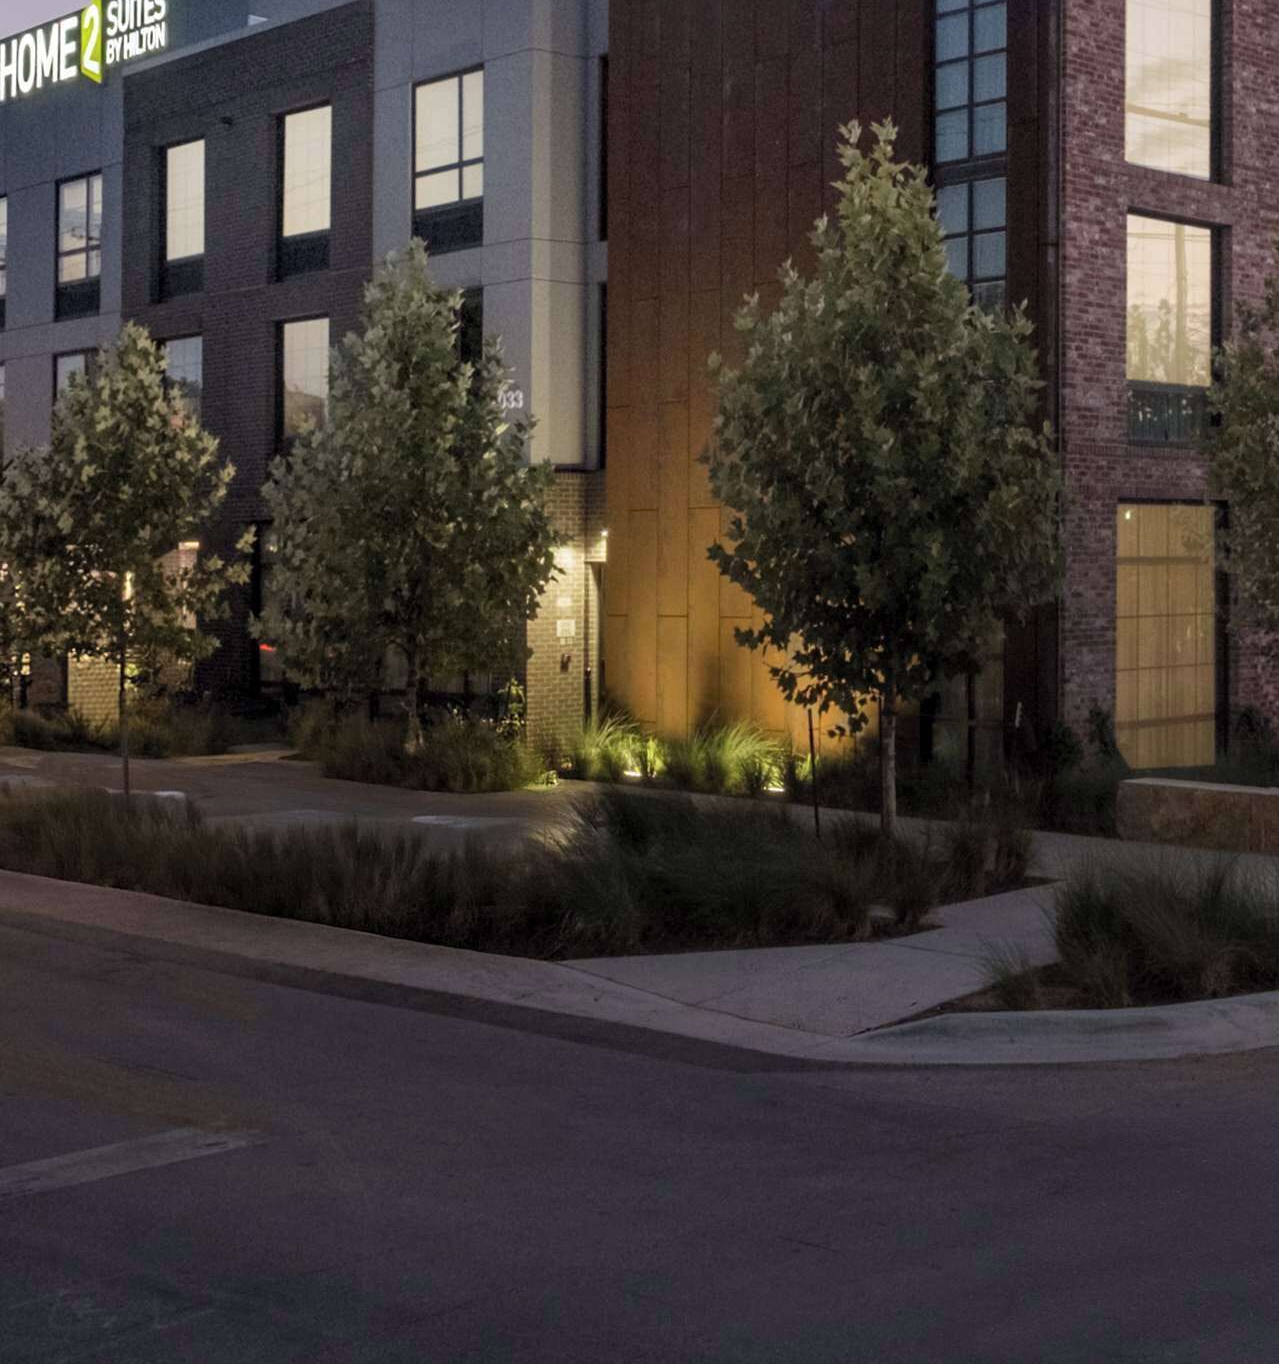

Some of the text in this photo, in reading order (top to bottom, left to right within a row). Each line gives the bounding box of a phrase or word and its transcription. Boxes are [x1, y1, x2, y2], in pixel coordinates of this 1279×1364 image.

[0, 3, 101, 102] HOME 2
[106, 21, 167, 64] BY HILTON
